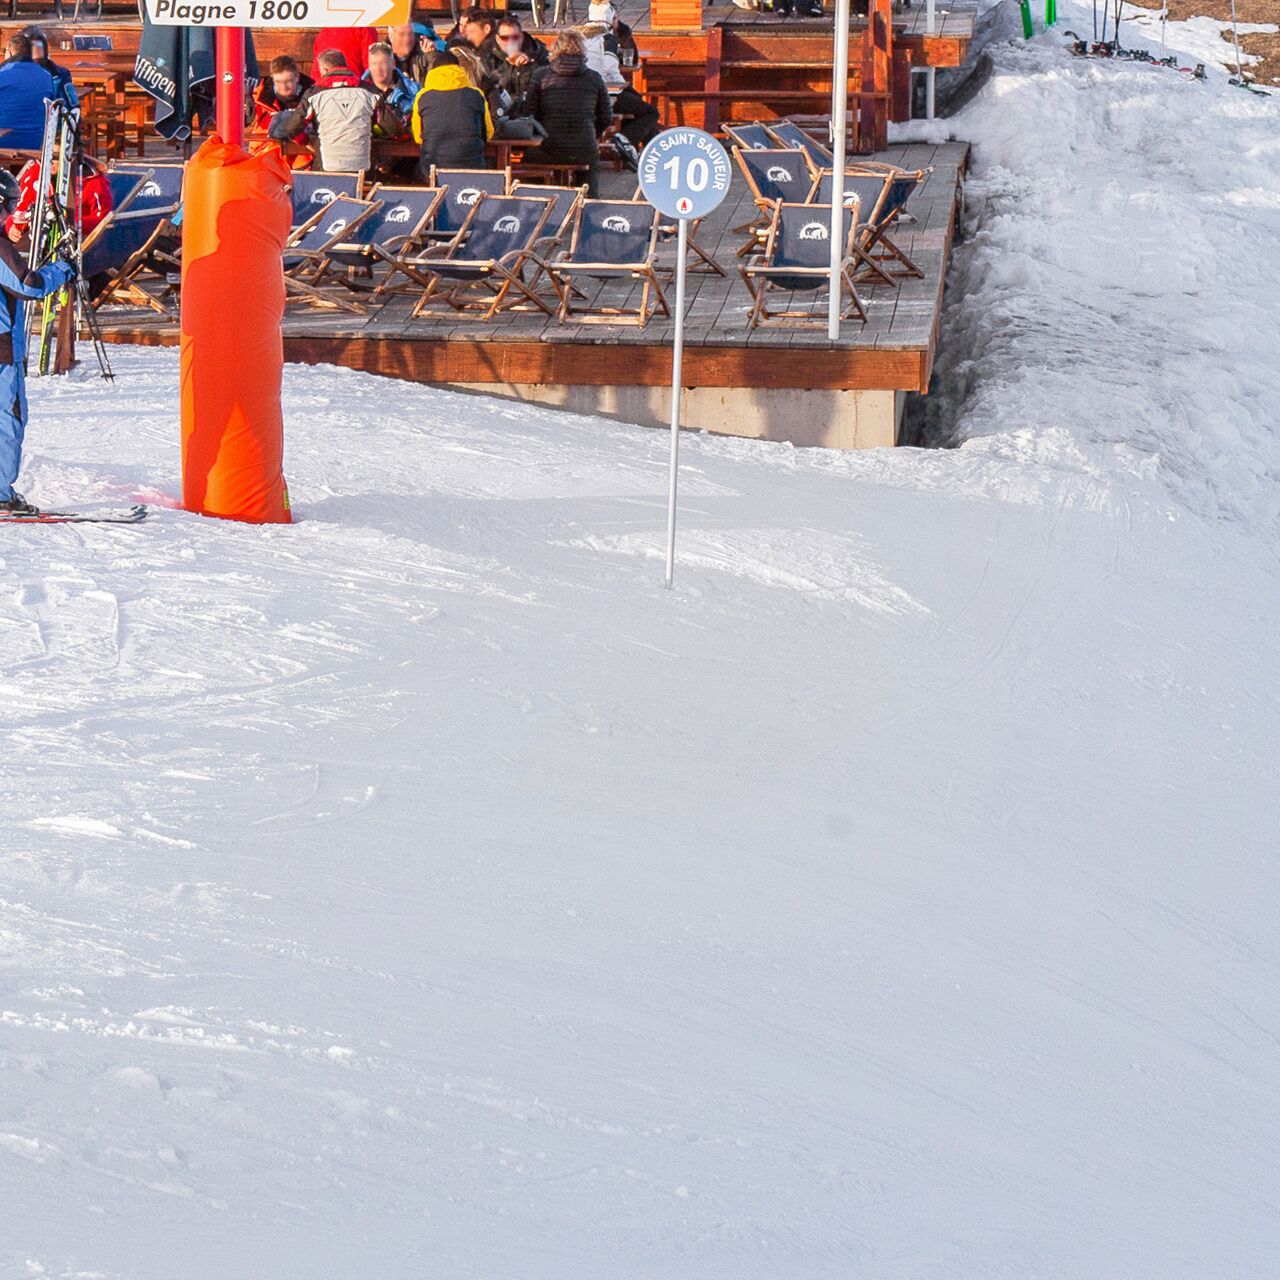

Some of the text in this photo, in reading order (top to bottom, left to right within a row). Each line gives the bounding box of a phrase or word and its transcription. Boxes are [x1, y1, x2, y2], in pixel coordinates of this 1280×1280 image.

[154, 0, 309, 24] Plagne 1800
[644, 133, 727, 191] MONT SAINT SAUVEUR
[663, 155, 709, 192] 10
